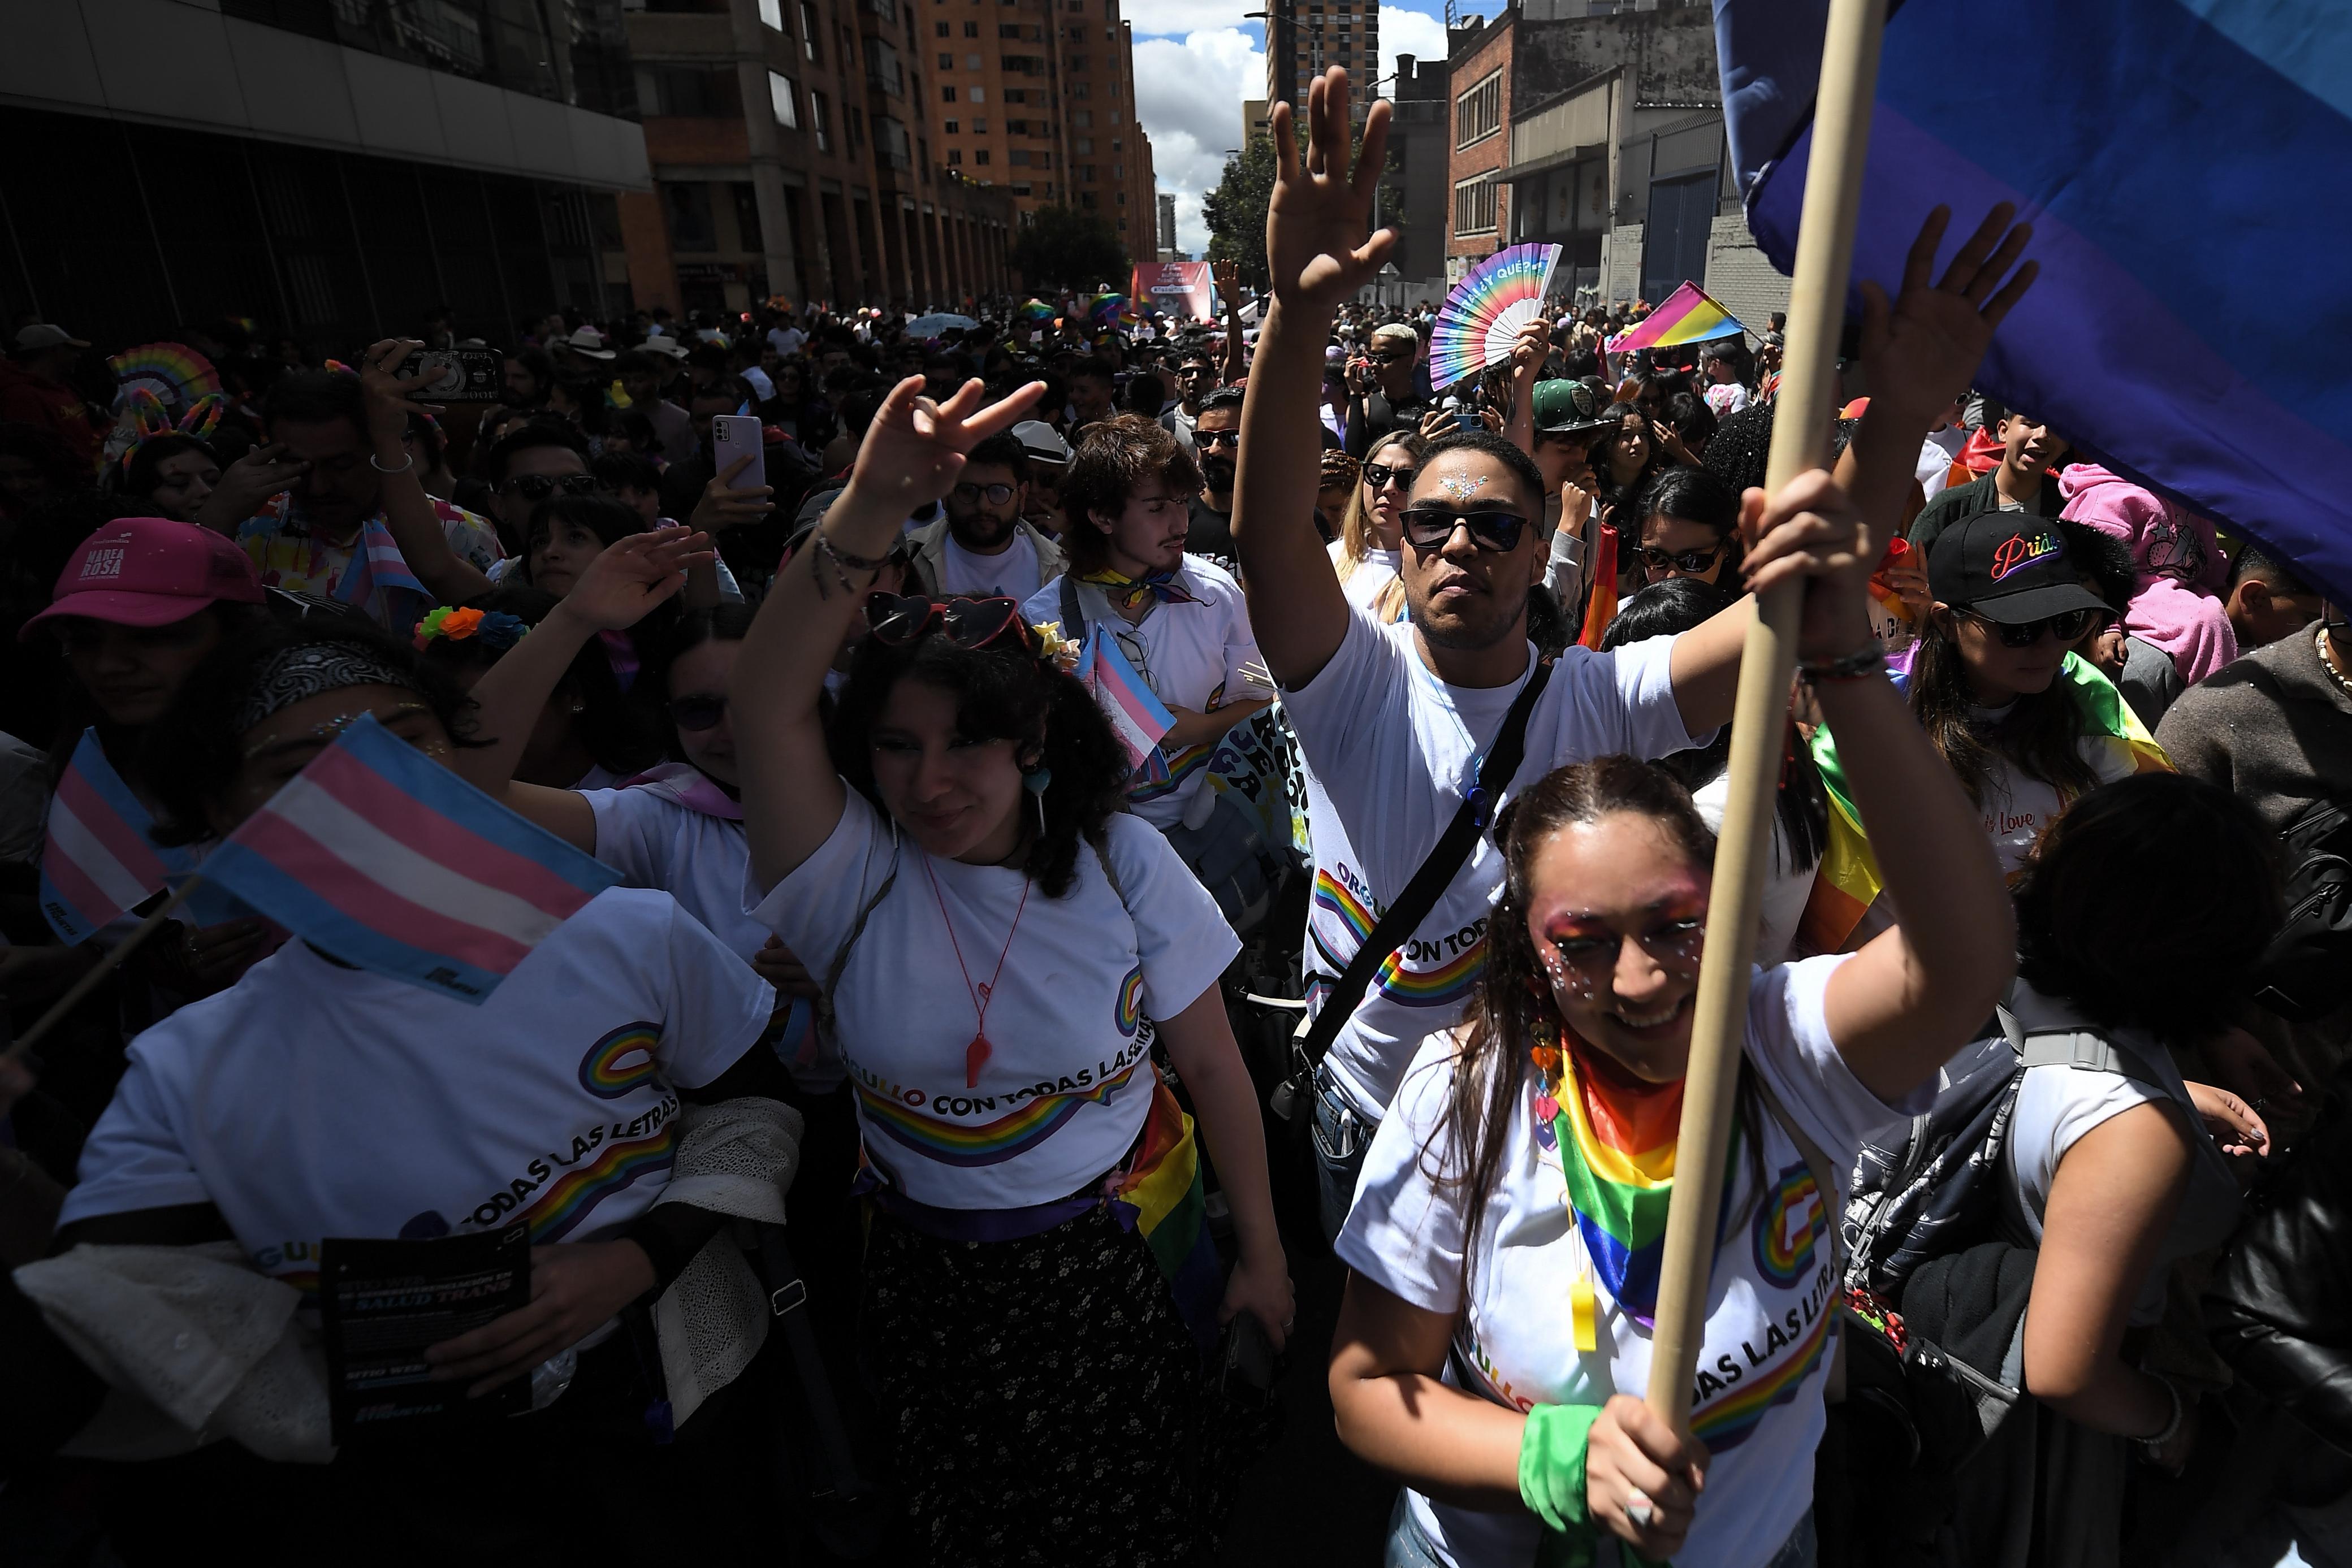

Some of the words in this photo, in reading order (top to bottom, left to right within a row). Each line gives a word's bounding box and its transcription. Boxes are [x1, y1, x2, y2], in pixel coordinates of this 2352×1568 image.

[1497, 259, 1530, 279] QUÉ?
[81, 559, 122, 577] ROSA
[86, 548, 124, 564] MAREA
[1991, 532, 2061, 579] Pride
[2000, 812, 2035, 835] Love
[1337, 861, 1386, 919] ORGU
[1406, 938, 1442, 963] ON
[1443, 917, 1488, 956] TOD
[933, 1095, 997, 1116] CON
[1099, 1043, 1135, 1079] LAS
[461, 1159, 551, 1225] ODAS
[549, 1125, 604, 1166] LAS
[609, 1095, 678, 1140] LETRAS
[1741, 1307, 1801, 1367] LAS
